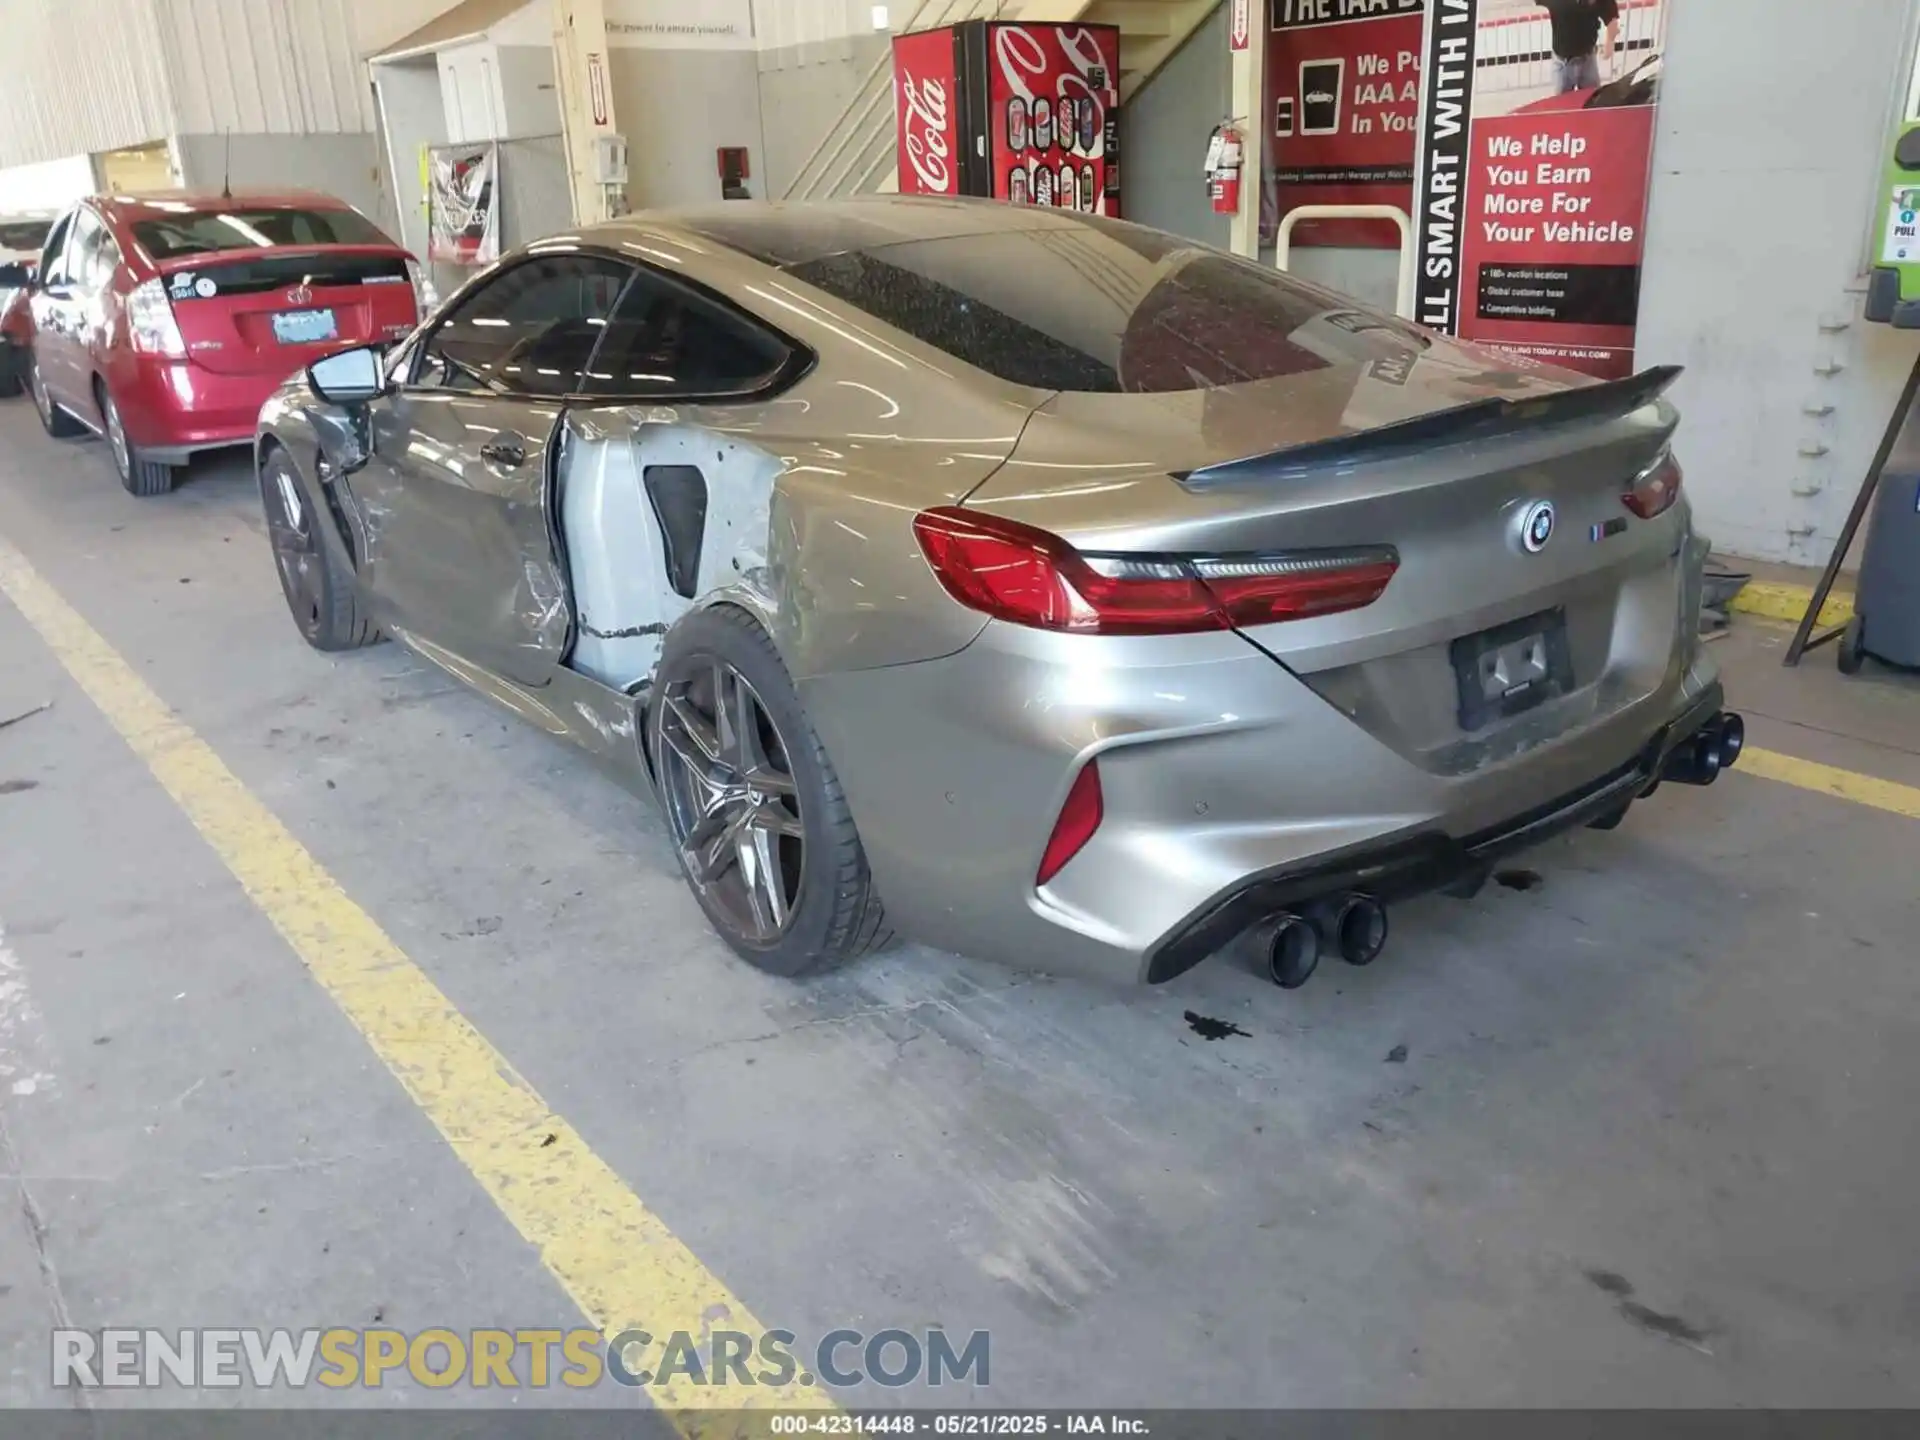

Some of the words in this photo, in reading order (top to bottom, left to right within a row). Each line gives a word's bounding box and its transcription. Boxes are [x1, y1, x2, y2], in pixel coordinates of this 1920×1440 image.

[655, 23, 665, 33] to
[1357, 54, 1389, 76] We
[1354, 82, 1395, 105] IAA
[1434, 38, 1467, 139] WITH
[1352, 113, 1372, 134] In
[1487, 136, 1523, 157] We
[1530, 132, 1586, 158] Help
[1486, 165, 1528, 186] You
[1537, 163, 1591, 185] Earn
[1426, 150, 1459, 278] SMART
[1484, 193, 1543, 214] More
[1551, 192, 1591, 213] For
[1482, 221, 1534, 242] Your
[1542, 220, 1634, 242] Vehicle
[1894, 226, 1915, 236] PULL
[1506, 270, 1533, 279] auction
[1534, 269, 1568, 280] locations
[1487, 287, 1511, 296] Global
[1511, 289, 1545, 298] customer
[1546, 289, 1564, 298] base
[1486, 304, 1527, 315] Competitive
[1528, 305, 1556, 317] bidding
[1532, 347, 1556, 356] TODAY
[1557, 349, 1567, 357] AT
